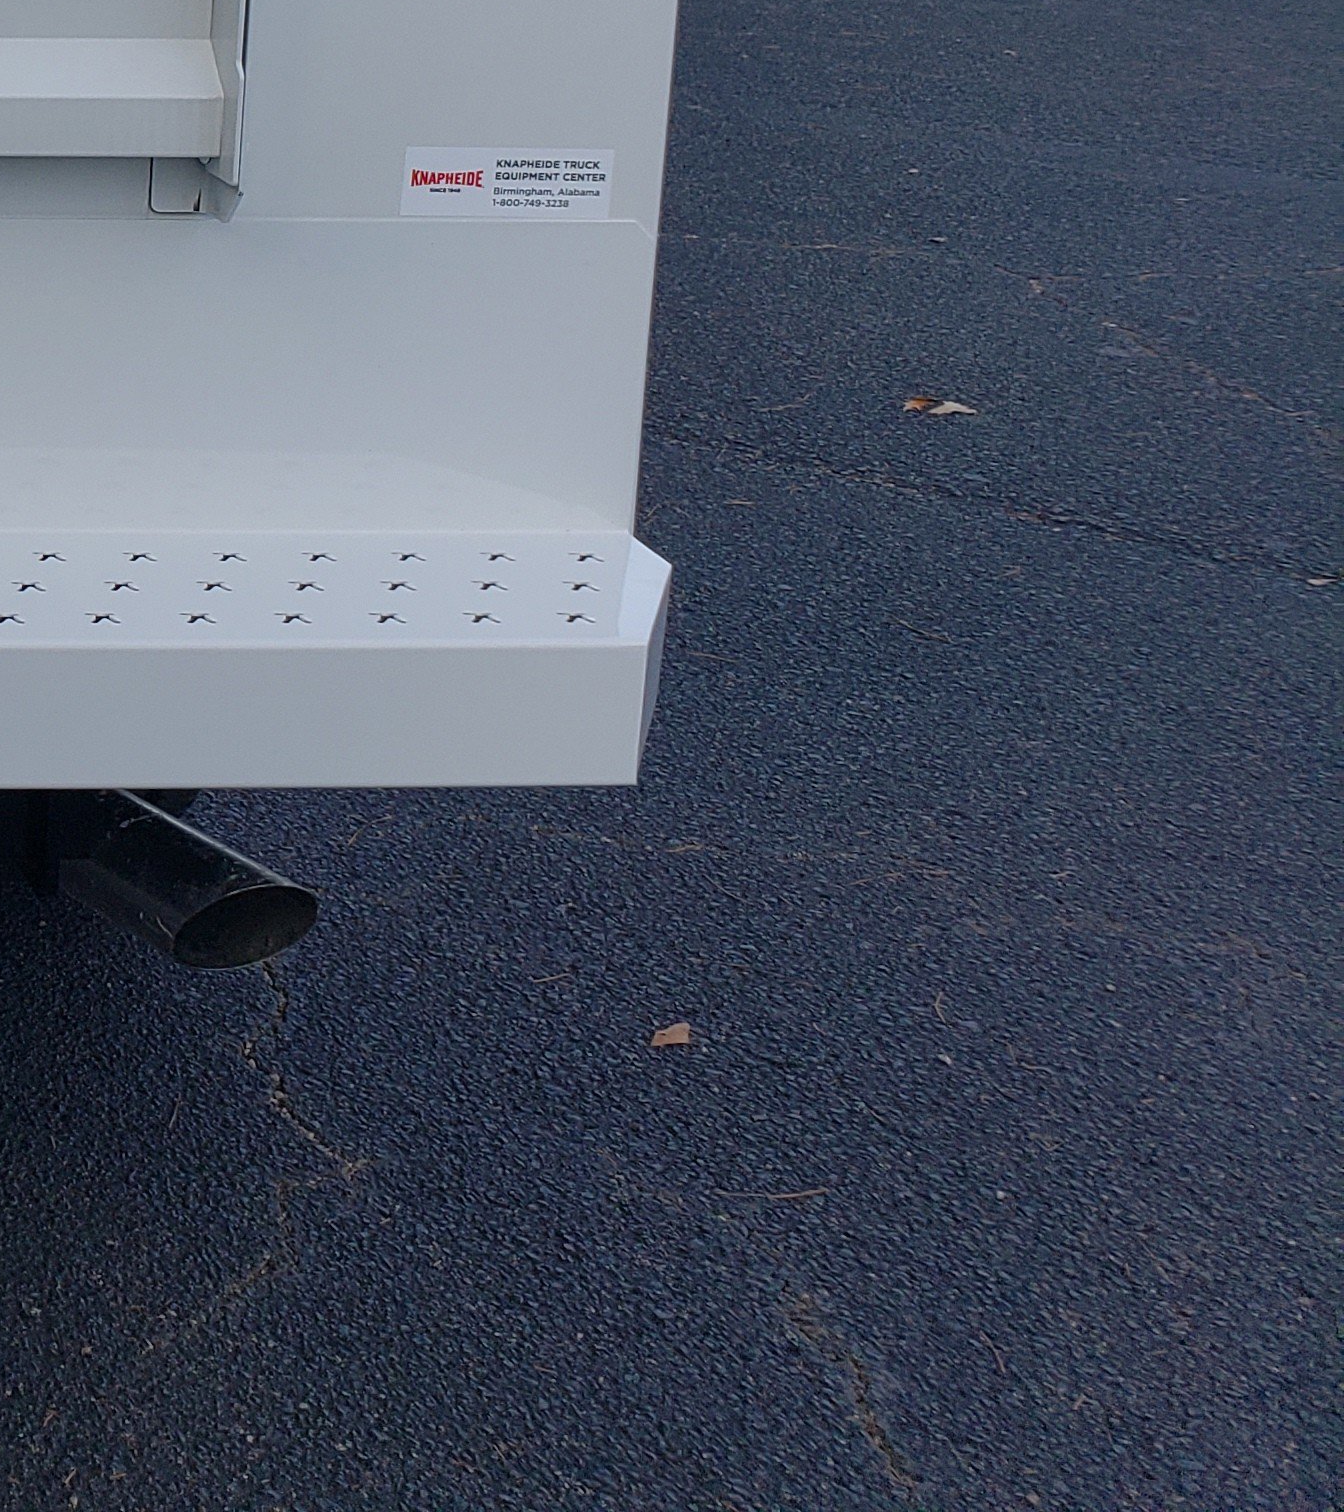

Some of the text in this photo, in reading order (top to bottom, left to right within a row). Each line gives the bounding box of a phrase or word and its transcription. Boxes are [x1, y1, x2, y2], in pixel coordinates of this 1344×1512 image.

[495, 159, 601, 170] KNAPHEIDE TRUCK
[411, 169, 484, 188] KNAPHEIDE
[495, 171, 606, 182] EQUIPMENT CENTER
[493, 187, 600, 197] Birmingham, Alabama
